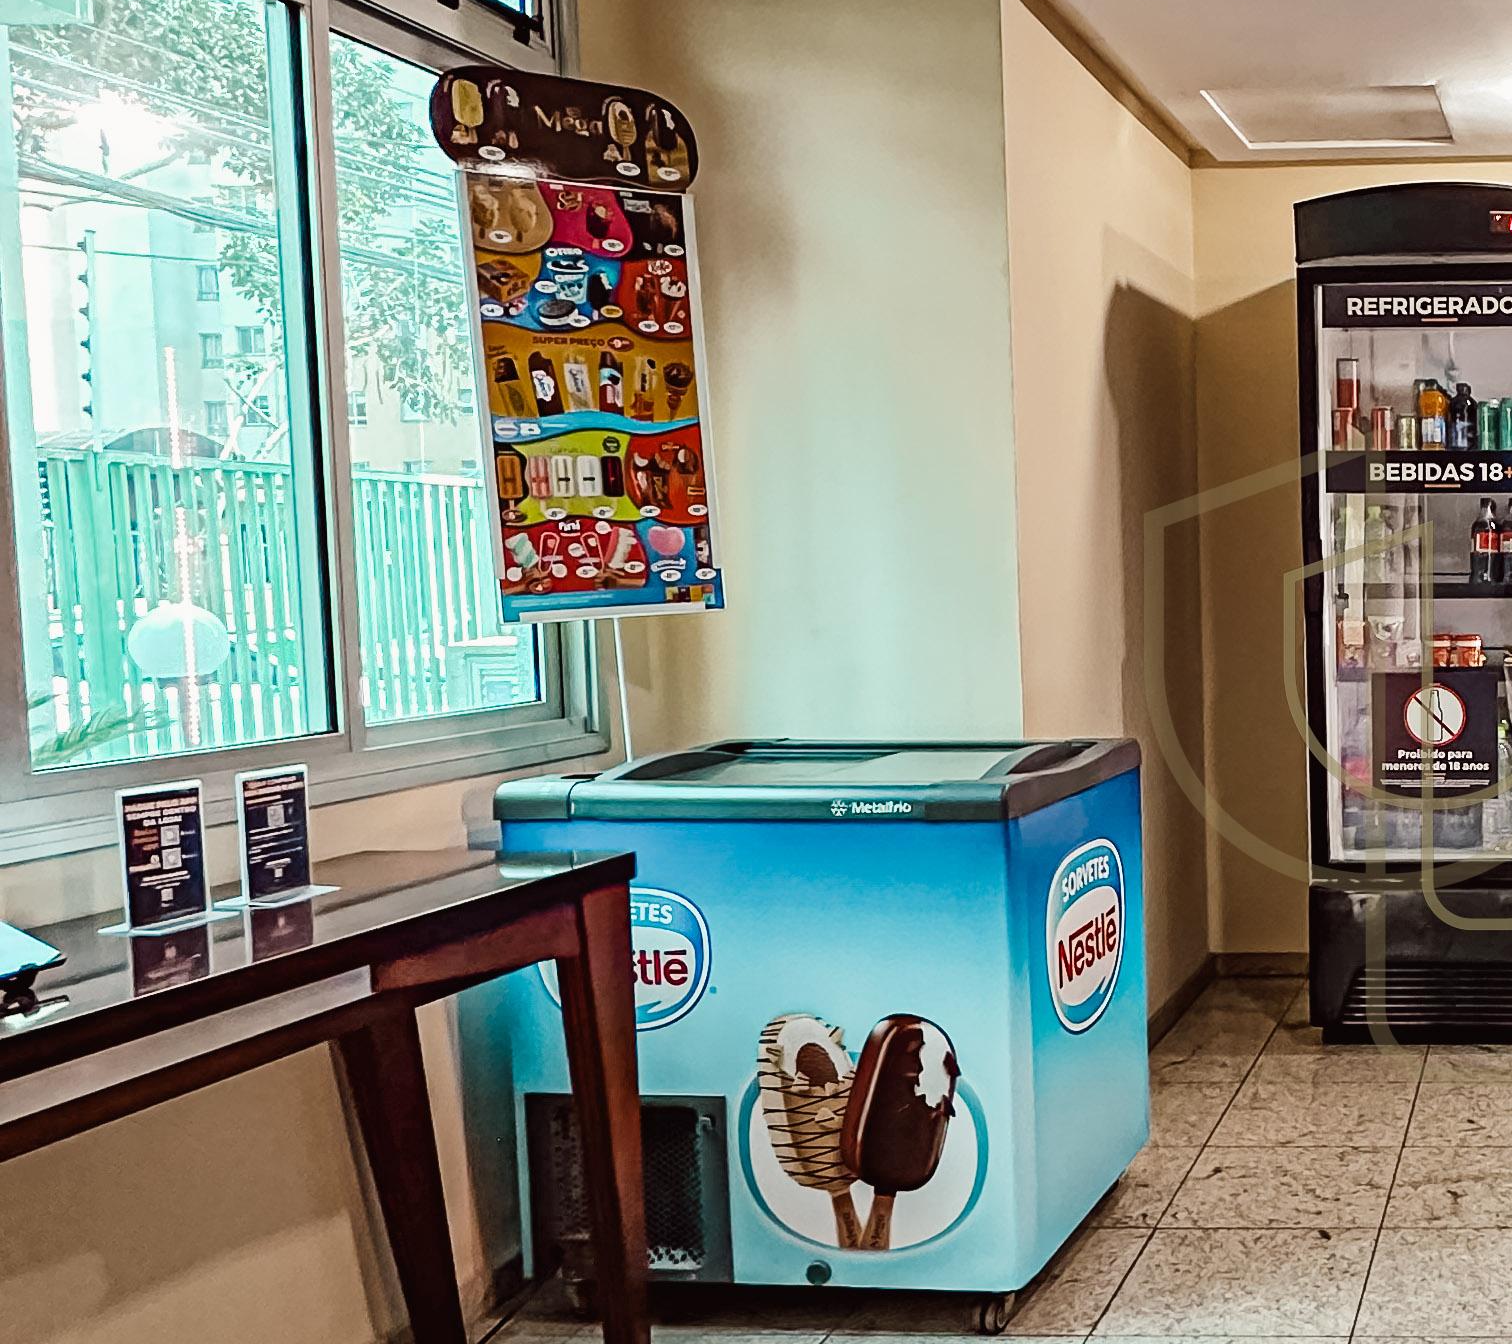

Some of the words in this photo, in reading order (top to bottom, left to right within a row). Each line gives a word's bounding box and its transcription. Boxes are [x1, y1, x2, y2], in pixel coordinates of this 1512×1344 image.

[1369, 462, 1475, 482] BEBIDAS
[1397, 748, 1446, 760] Proibido
[1447, 750, 1473, 761] para
[1381, 761, 1431, 771] menores
[1432, 761, 1447, 771] de
[1448, 761, 1461, 771] 18
[1462, 762, 1490, 771] anos
[1062, 855, 1110, 903] SORVETES
[630, 901, 673, 925] ETES
